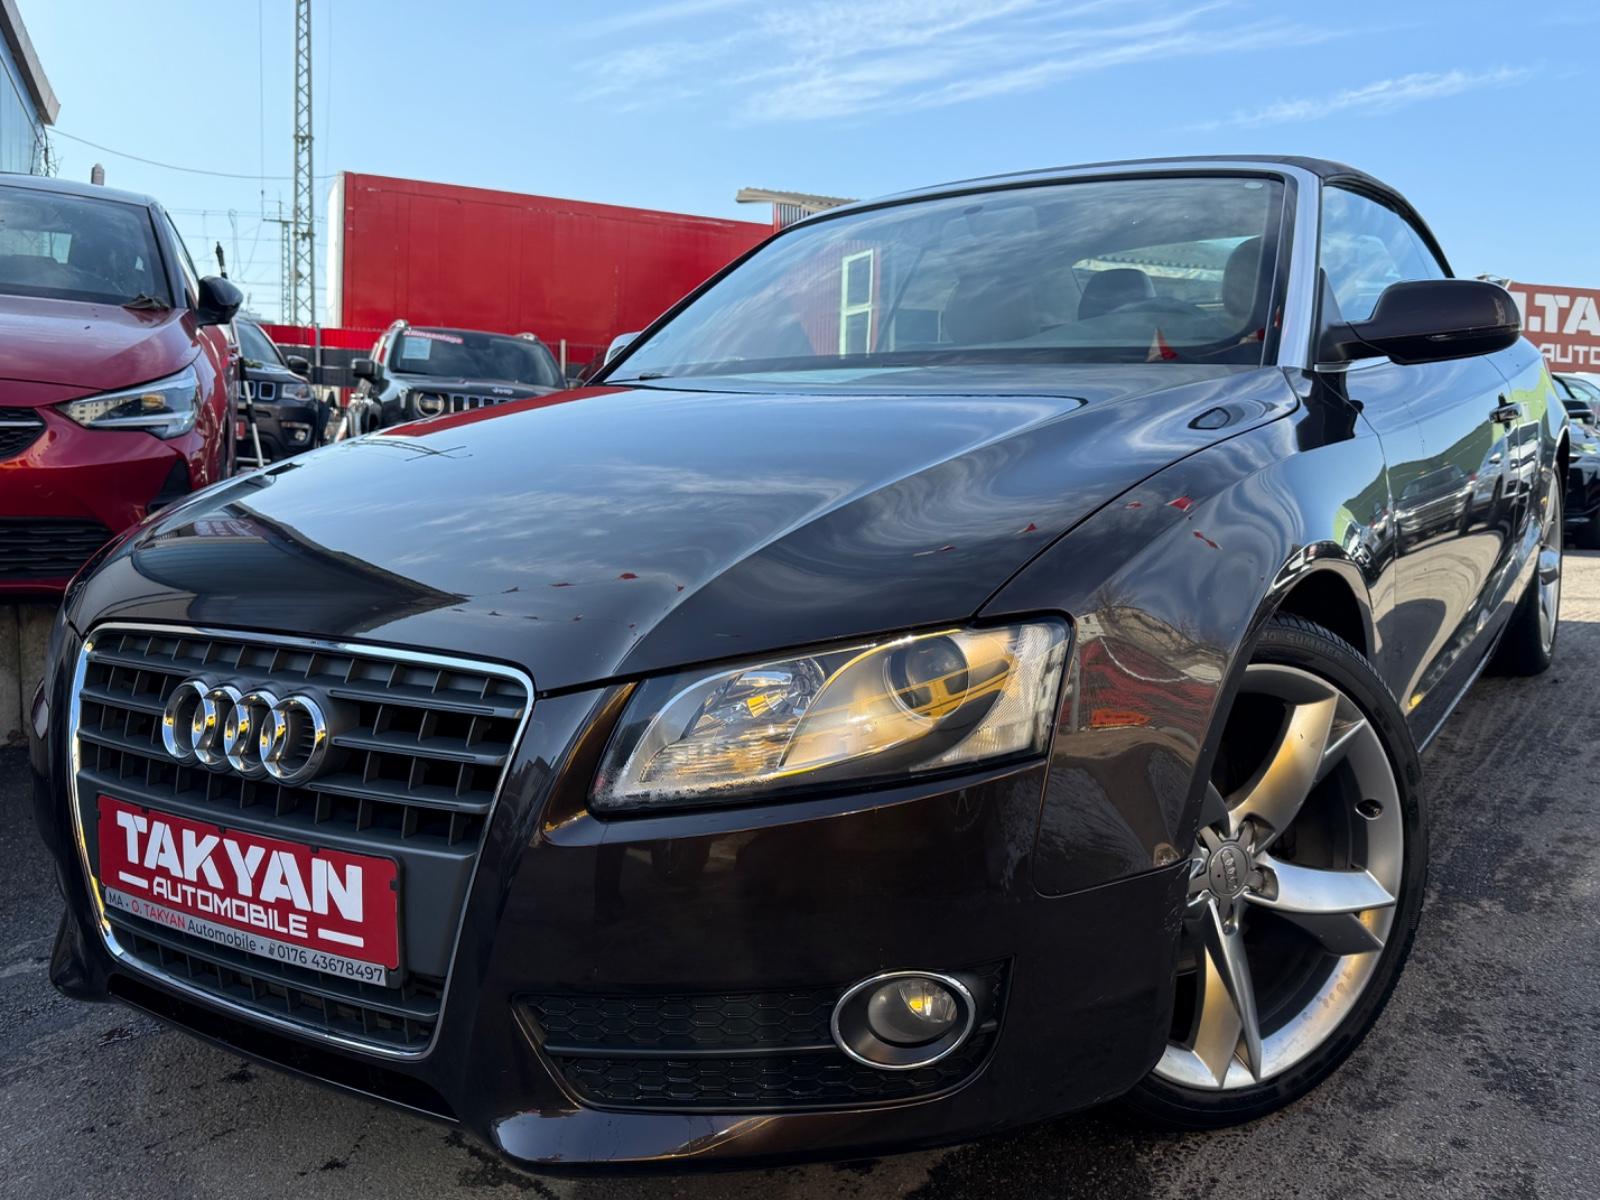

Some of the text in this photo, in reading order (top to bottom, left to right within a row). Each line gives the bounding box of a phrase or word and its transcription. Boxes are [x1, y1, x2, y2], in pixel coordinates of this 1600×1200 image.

[116, 810, 363, 923] TAKYAN
[144, 904, 186, 929] TAKYAN
[187, 920, 257, 951] Automobile
[277, 944, 307, 965] 0176
[311, 954, 383, 983] 43678497
[153, 876, 308, 939] AUTOMOBILE
